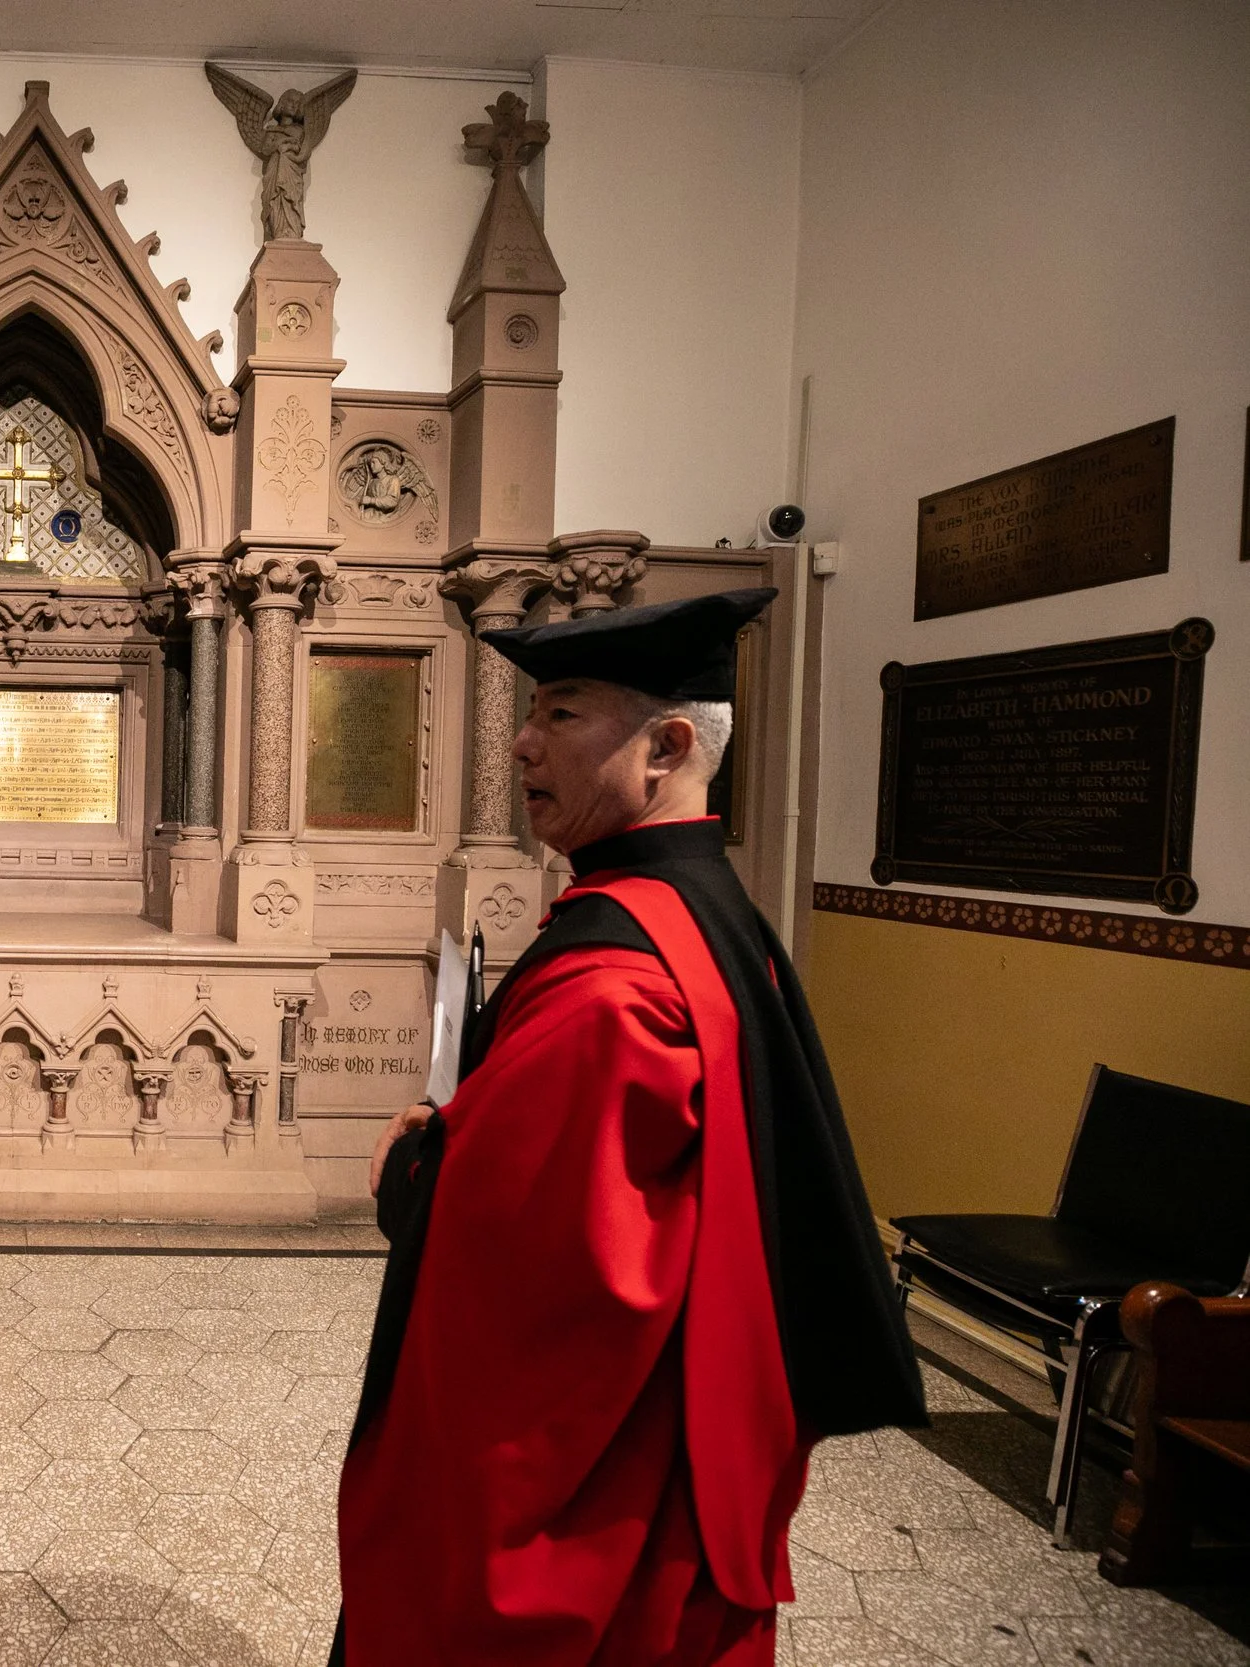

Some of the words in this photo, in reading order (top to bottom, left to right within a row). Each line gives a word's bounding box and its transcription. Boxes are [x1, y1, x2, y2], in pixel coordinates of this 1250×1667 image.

[990, 481, 1023, 501] VOX
[972, 524, 1033, 555] ALLAN
[1079, 676, 1098, 688] OF
[916, 698, 1018, 722] ELIZABETH
[1032, 686, 1152, 713] HAMMOND
[1036, 715, 1054, 727] OF
[921, 733, 981, 750] EDWARD
[988, 731, 1035, 746] SWAN
[1045, 725, 1140, 744] STICKNEY
[1010, 748, 1042, 760] JULY
[1034, 761, 1049, 772] OF
[1055, 760, 1082, 772] HER
[1090, 758, 1150, 772] HELPFUL
[1076, 776, 1104, 788] HER
[1110, 775, 1149, 788] MANY
[992, 791, 1035, 802] PARISH
[1041, 791, 1070, 802] THIS
[1077, 791, 1149, 803] MEMORIAL
[322, 1026, 391, 1045] MEMORY
[397, 1027, 420, 1045] OF
[379, 1057, 422, 1075] FELL.
